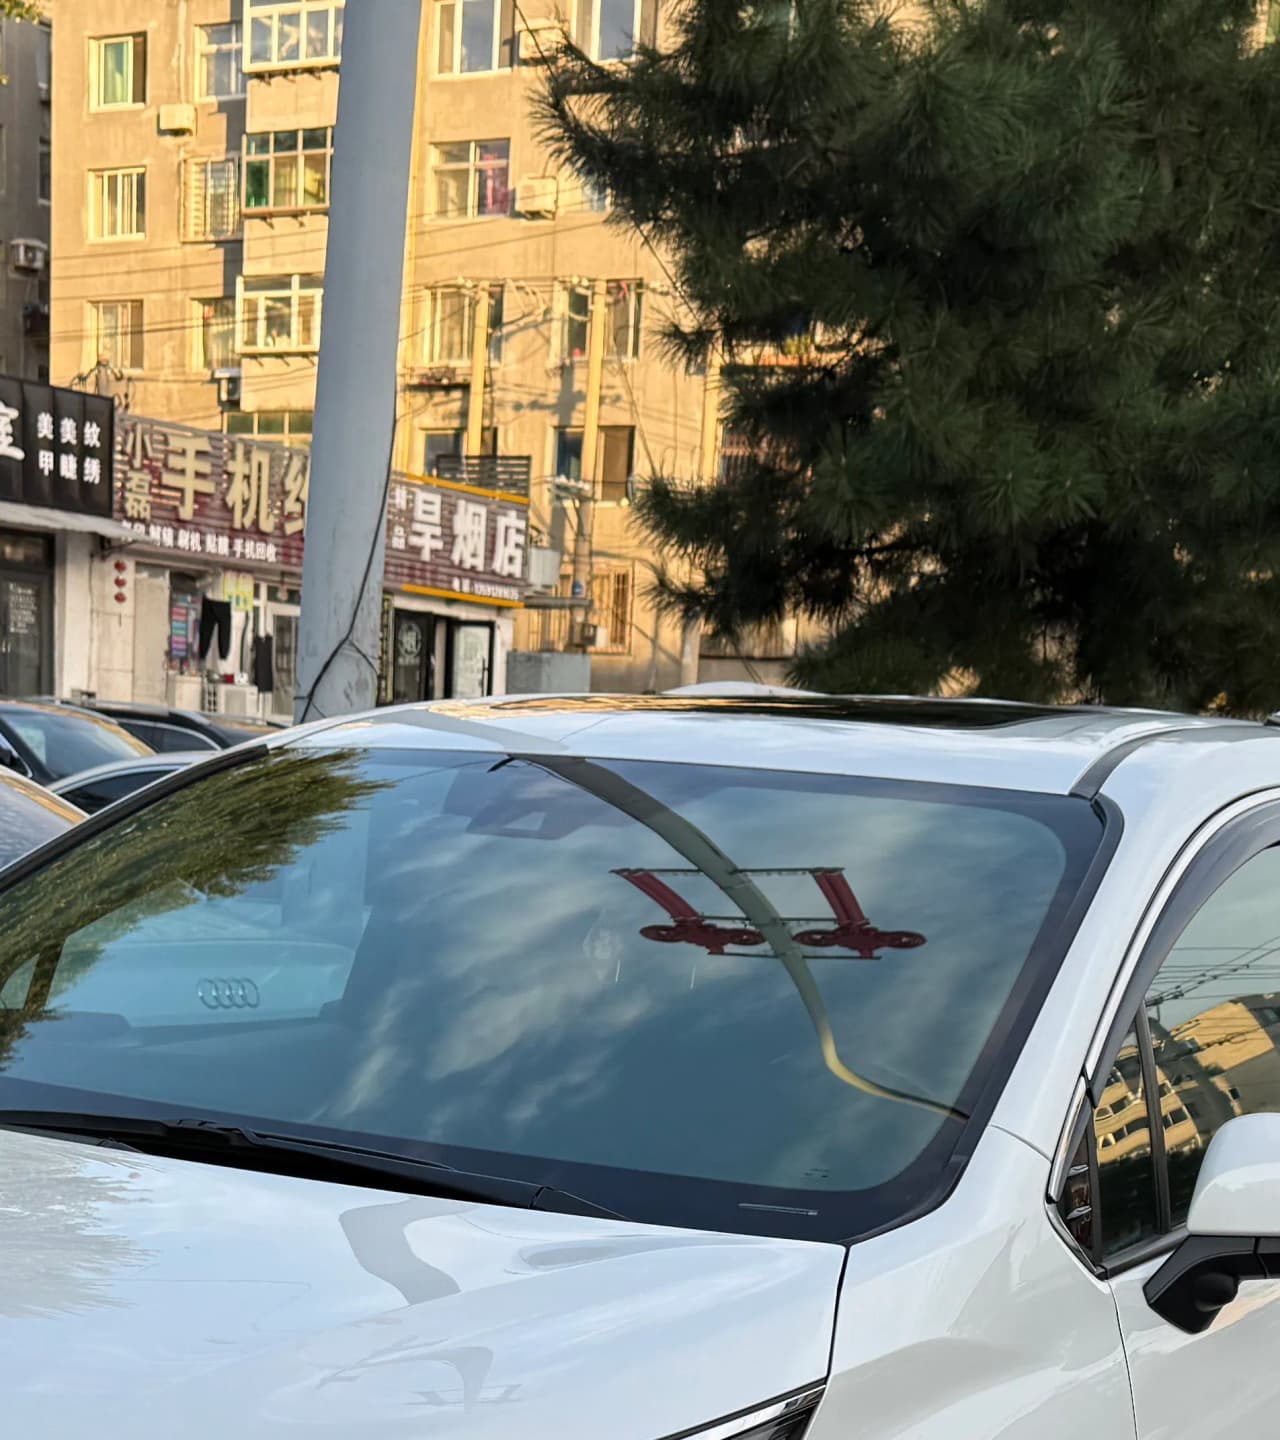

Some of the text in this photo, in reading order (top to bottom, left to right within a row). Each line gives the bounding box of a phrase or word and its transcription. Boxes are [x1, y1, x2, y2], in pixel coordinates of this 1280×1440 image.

[233, 538, 277, 563] 手机回收
[407, 489, 526, 579] 旱烟店
